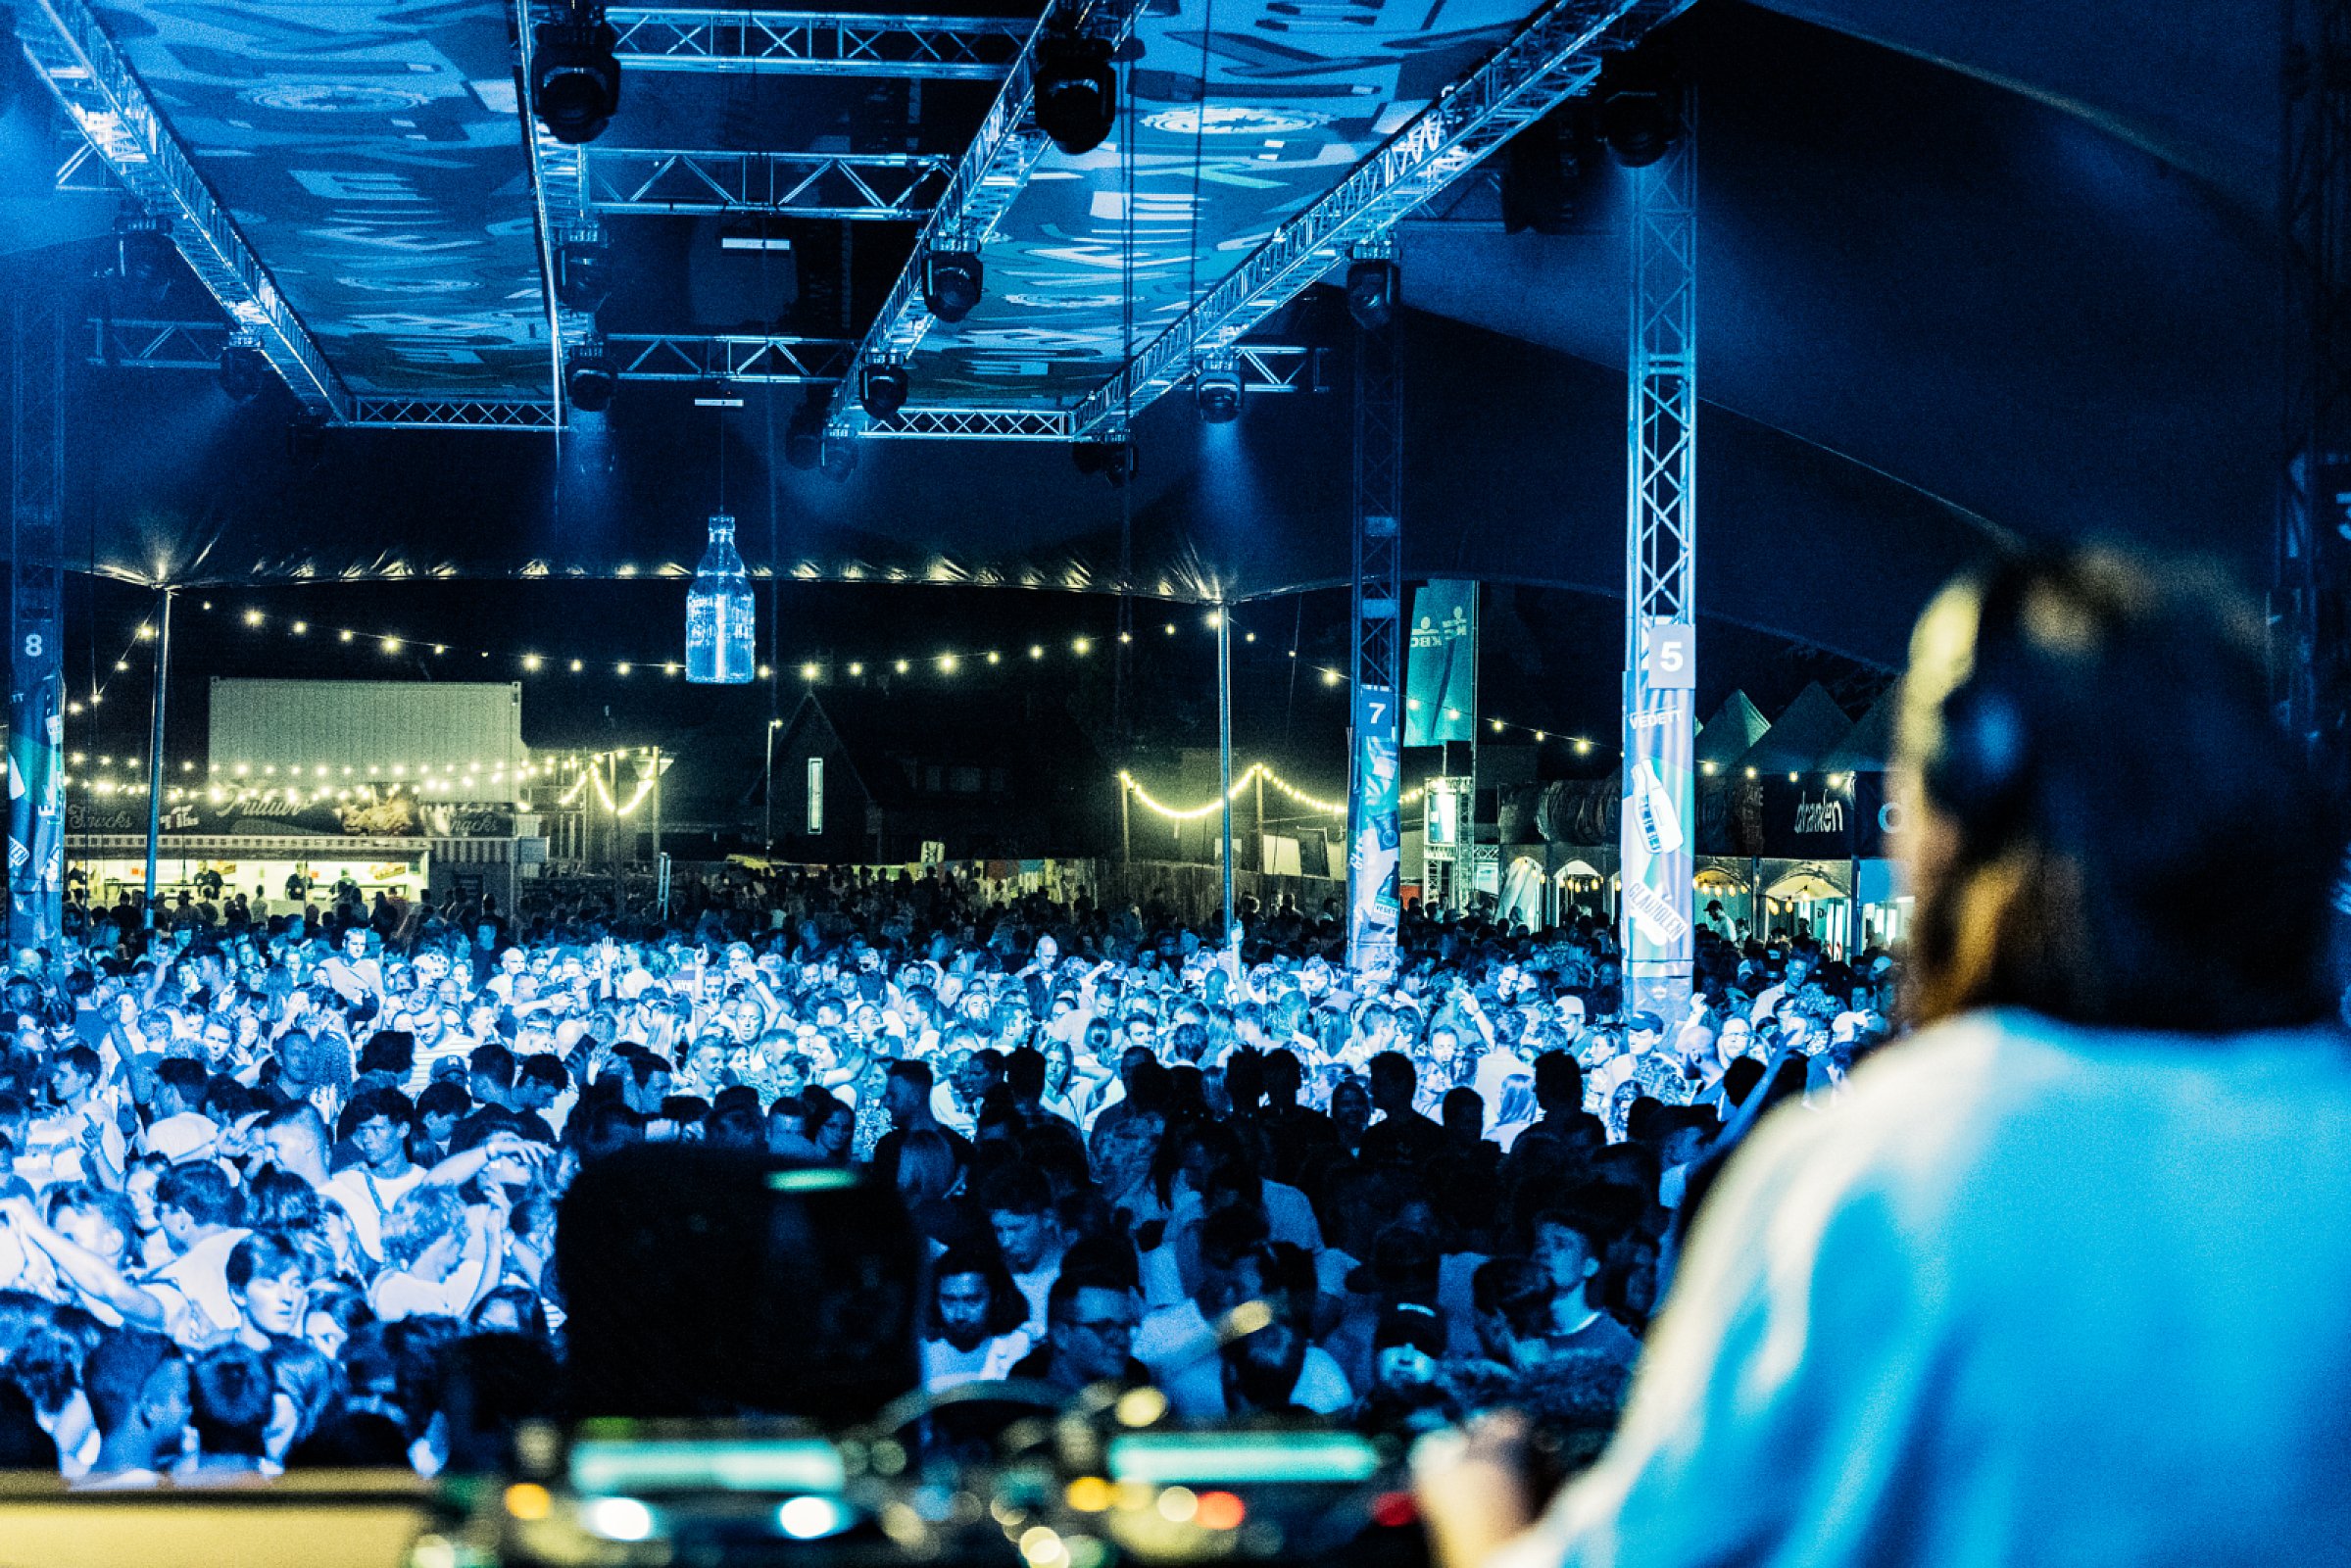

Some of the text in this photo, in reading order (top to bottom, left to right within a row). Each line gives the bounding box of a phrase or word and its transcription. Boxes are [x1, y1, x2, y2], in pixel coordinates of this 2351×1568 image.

[25, 633, 42, 657] 8
[1659, 641, 1684, 672] 5
[1369, 702, 1387, 723] 7
[1629, 709, 1683, 730] VEDETT
[1794, 789, 1843, 834] dranken
